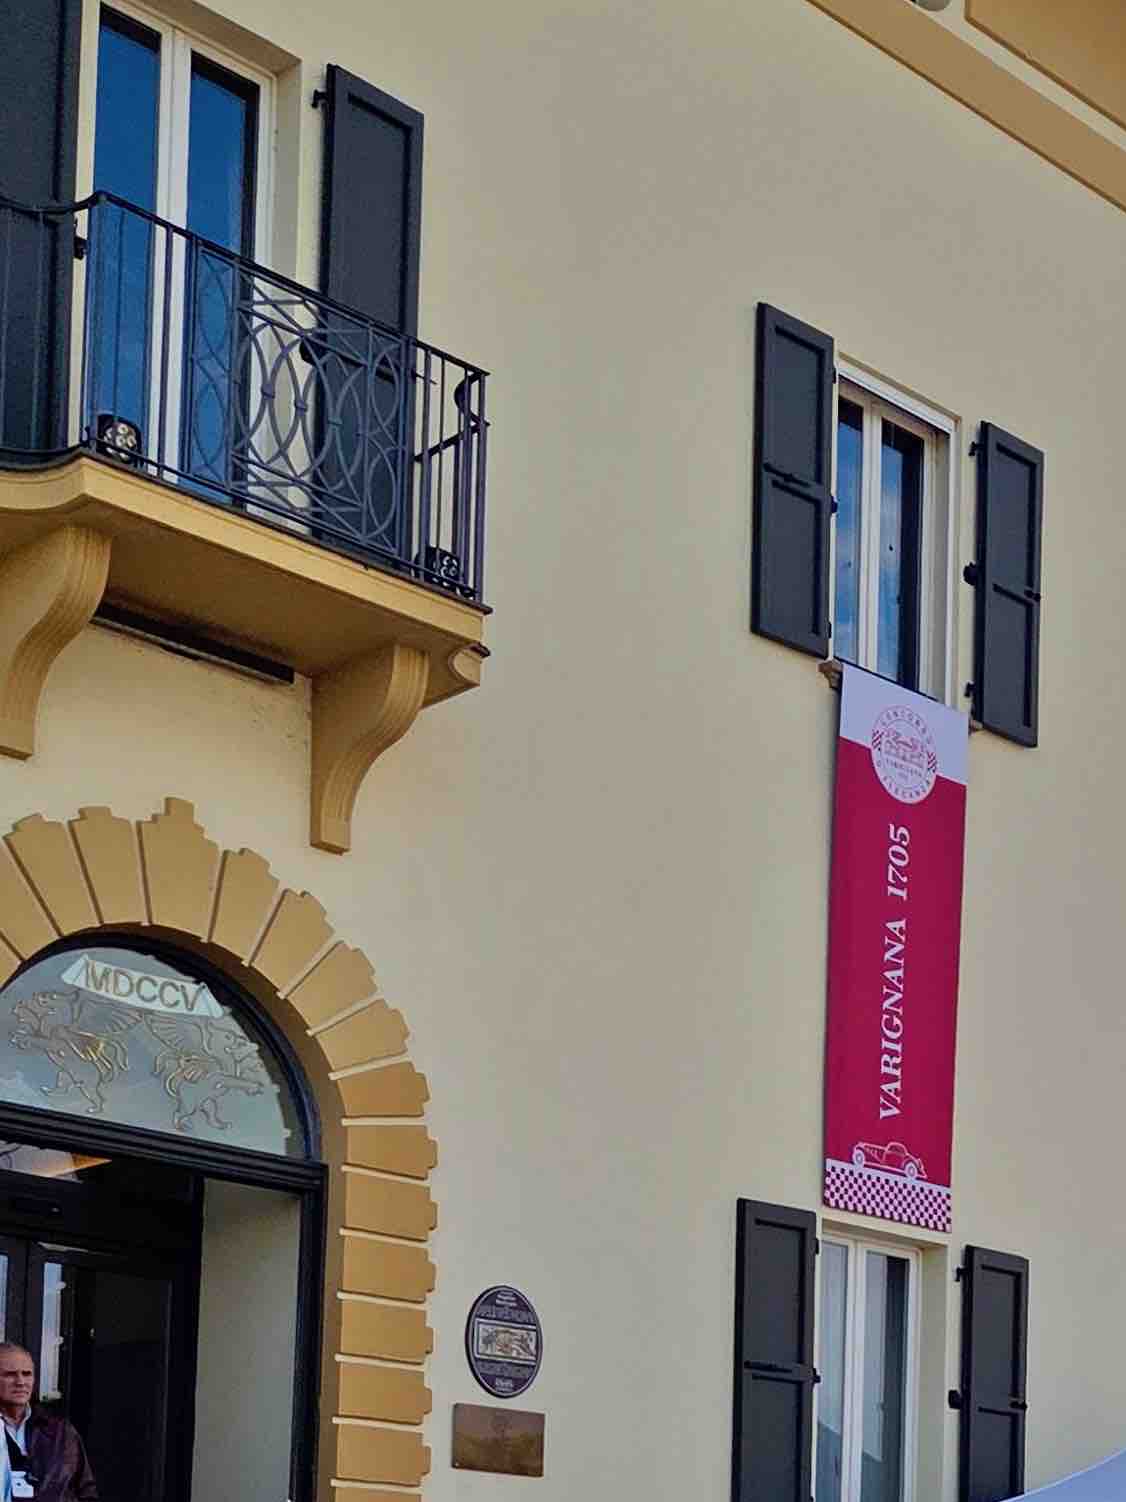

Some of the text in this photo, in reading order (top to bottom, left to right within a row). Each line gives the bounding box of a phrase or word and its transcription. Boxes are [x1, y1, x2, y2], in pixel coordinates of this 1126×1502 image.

[86, 960, 202, 1011] MDCCV
[879, 823, 911, 1120] VARIGNANA 1705
